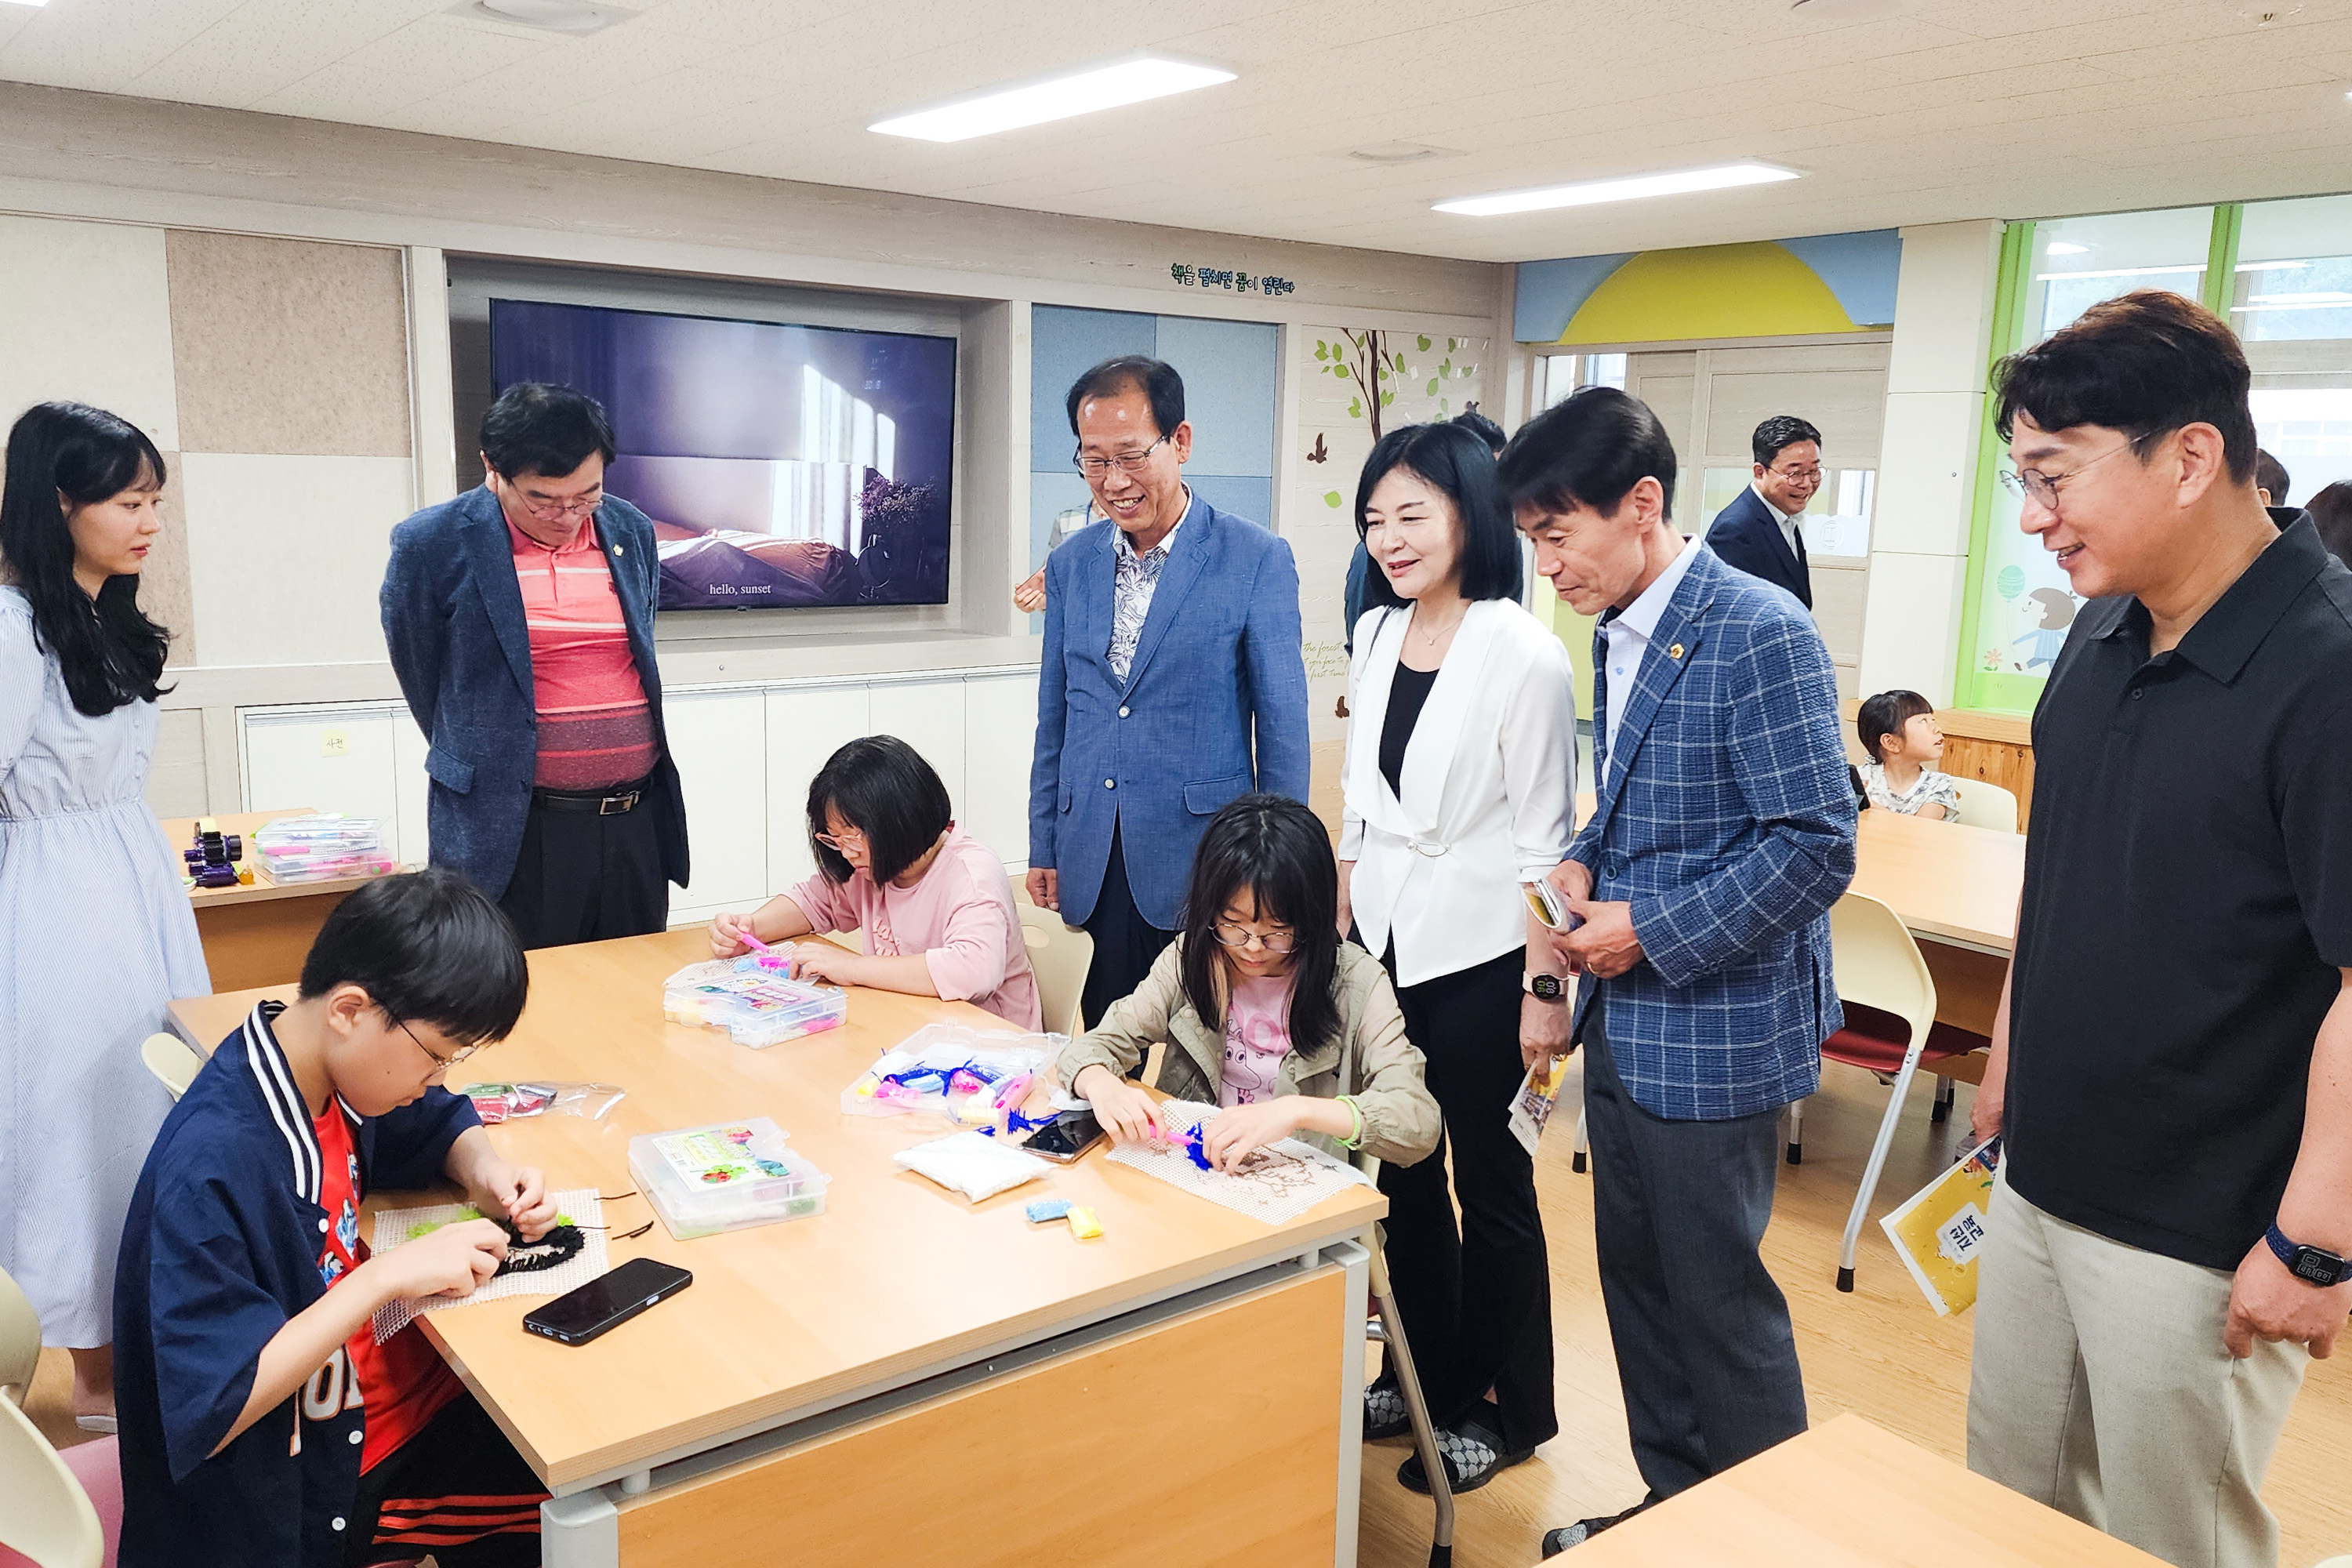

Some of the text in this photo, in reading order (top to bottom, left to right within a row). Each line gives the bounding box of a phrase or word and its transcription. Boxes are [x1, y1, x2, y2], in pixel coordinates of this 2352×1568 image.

[1171, 263, 1295, 295] 책을 펼치면 꿈이 열린다
[710, 583, 771, 596] hello, sunset
[326, 738, 343, 749] 사전
[1949, 1225, 1973, 1252] 지산
[1962, 1214, 1984, 1241] 교육
